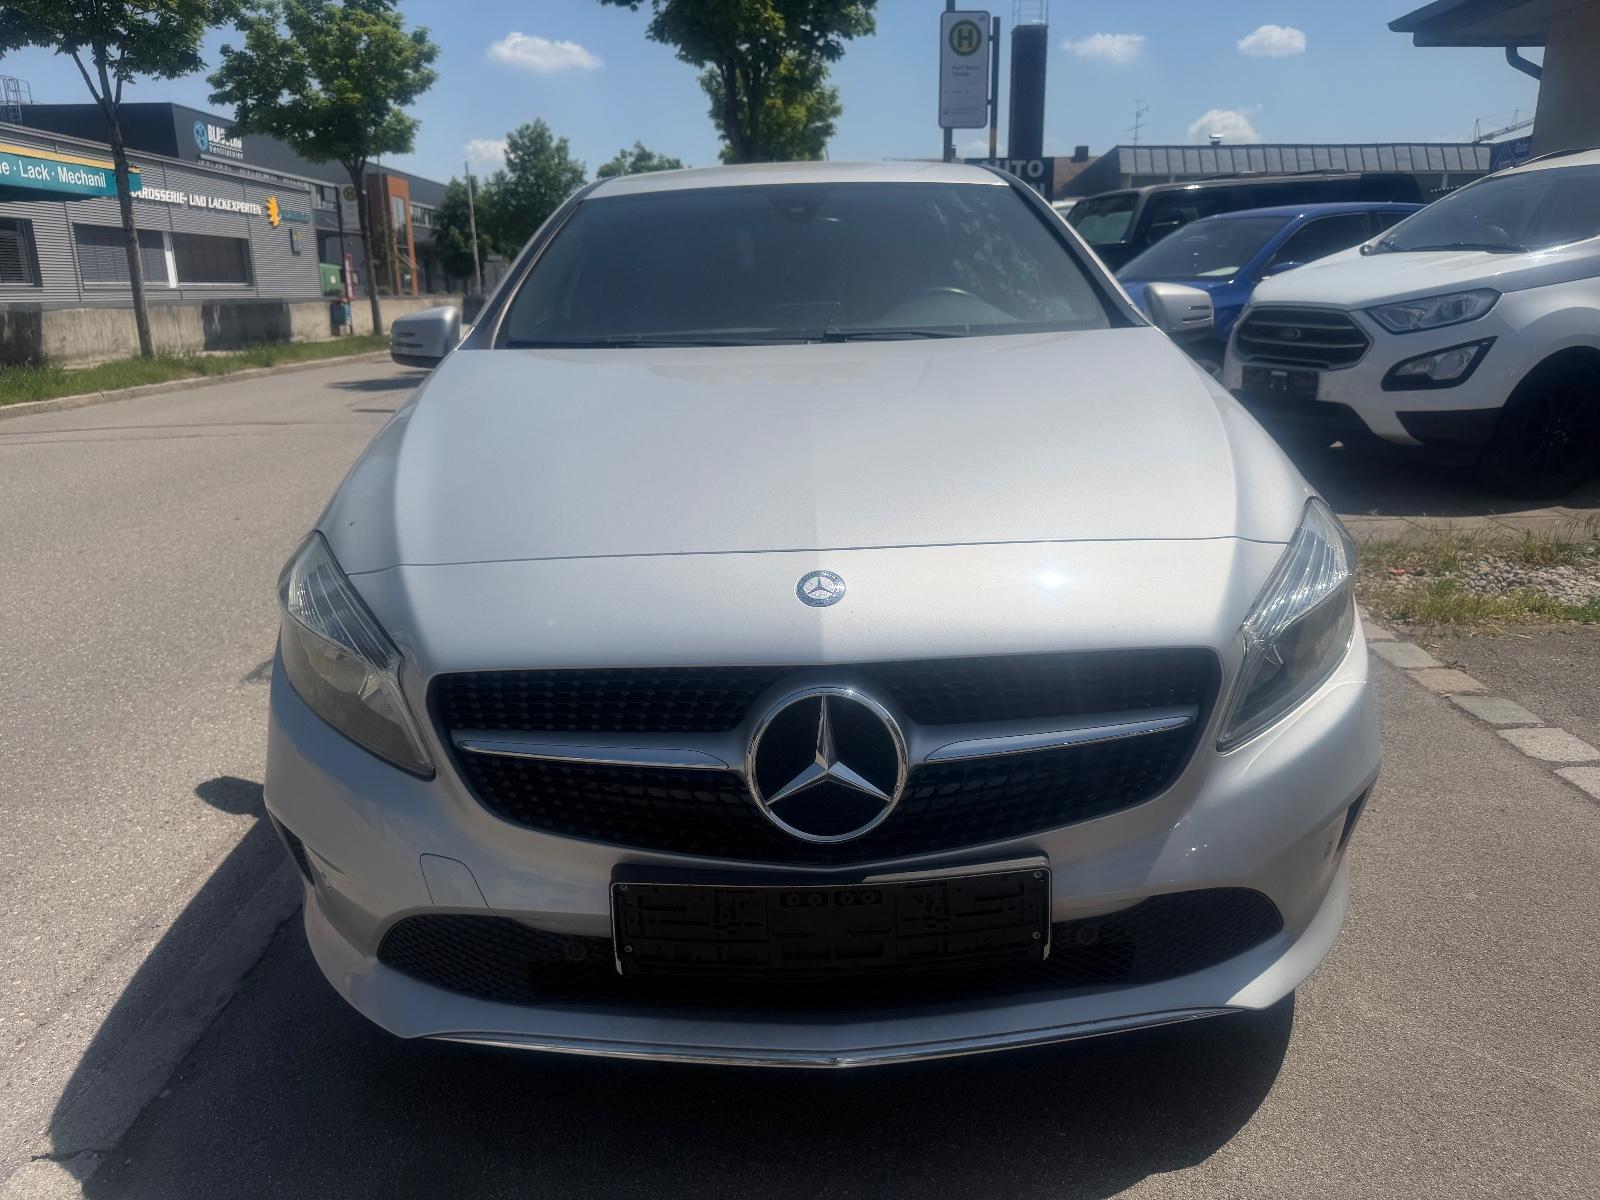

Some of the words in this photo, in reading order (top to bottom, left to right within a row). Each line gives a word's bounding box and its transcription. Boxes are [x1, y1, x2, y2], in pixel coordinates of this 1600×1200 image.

[957, 28, 973, 49] H
[18, 160, 50, 180] Lack
[981, 160, 1044, 178] UTO
[189, 194, 207, 208] UND
[208, 197, 262, 216] LACKEXPERTEN
